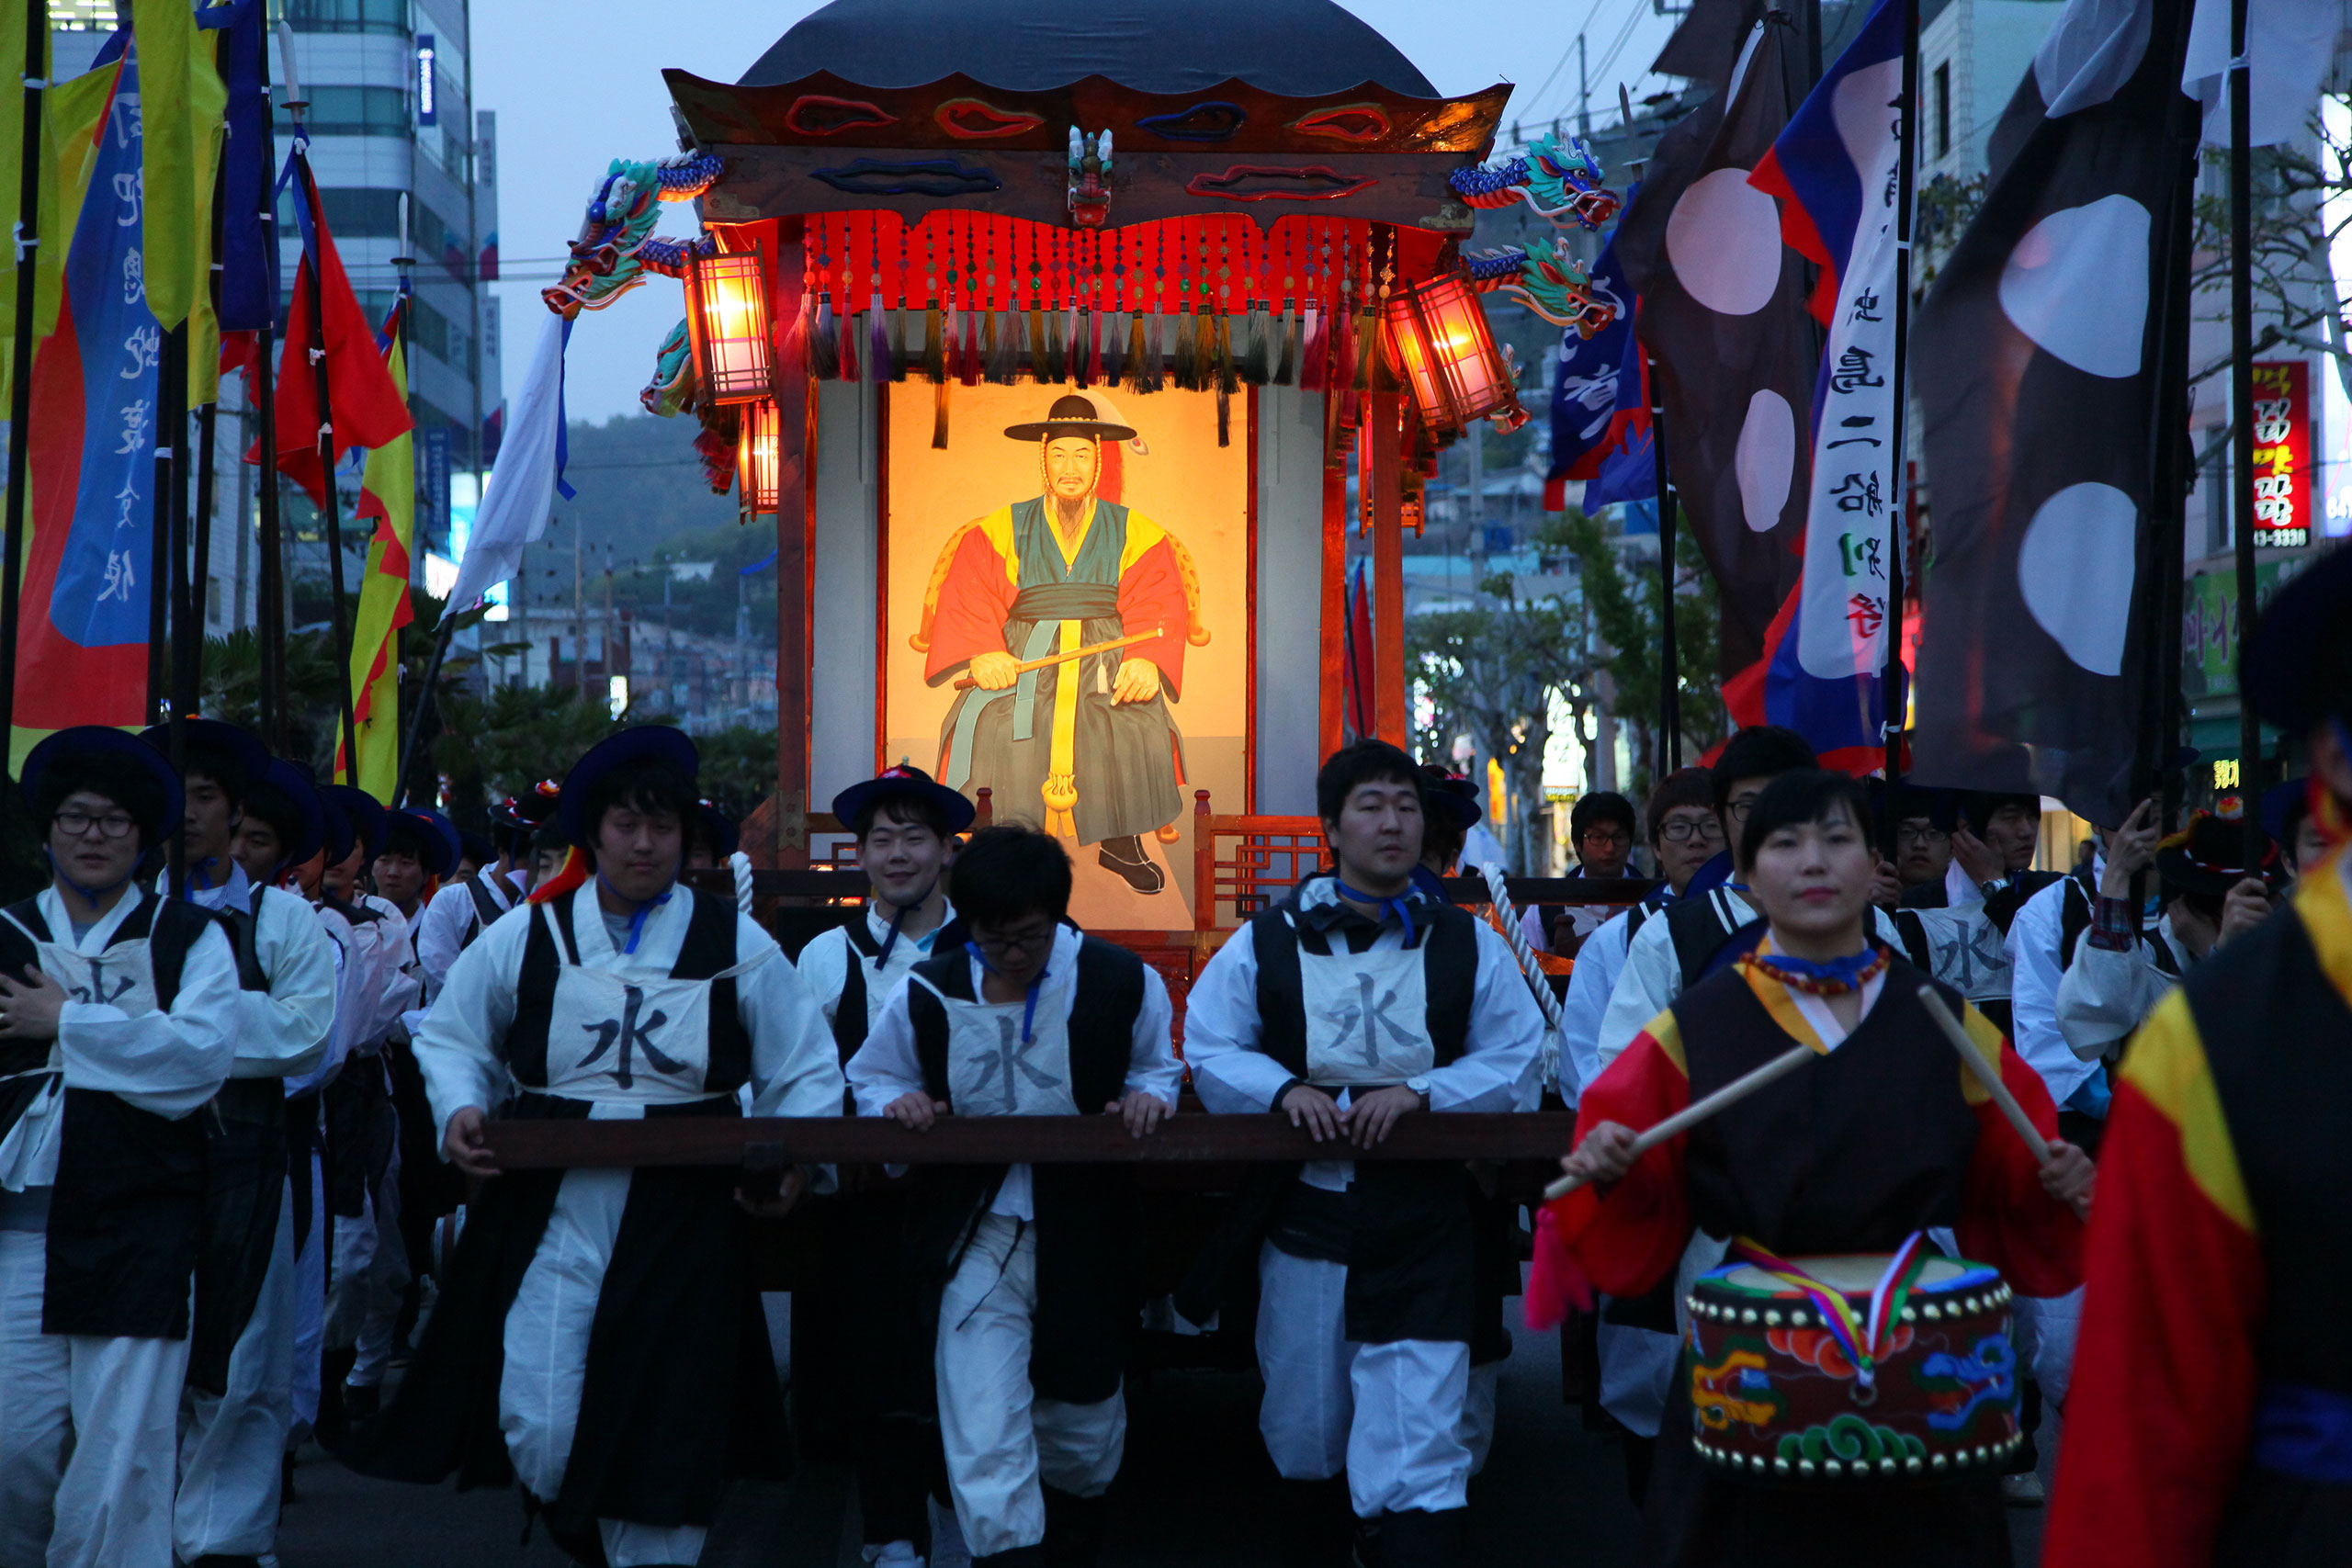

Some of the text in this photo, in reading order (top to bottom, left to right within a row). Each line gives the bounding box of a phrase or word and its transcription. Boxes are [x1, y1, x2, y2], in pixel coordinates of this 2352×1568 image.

[1936, 919, 2008, 988] 水
[576, 985, 688, 1090] 水
[967, 1014, 1062, 1113] 水
[1327, 972, 1422, 1067] 水
